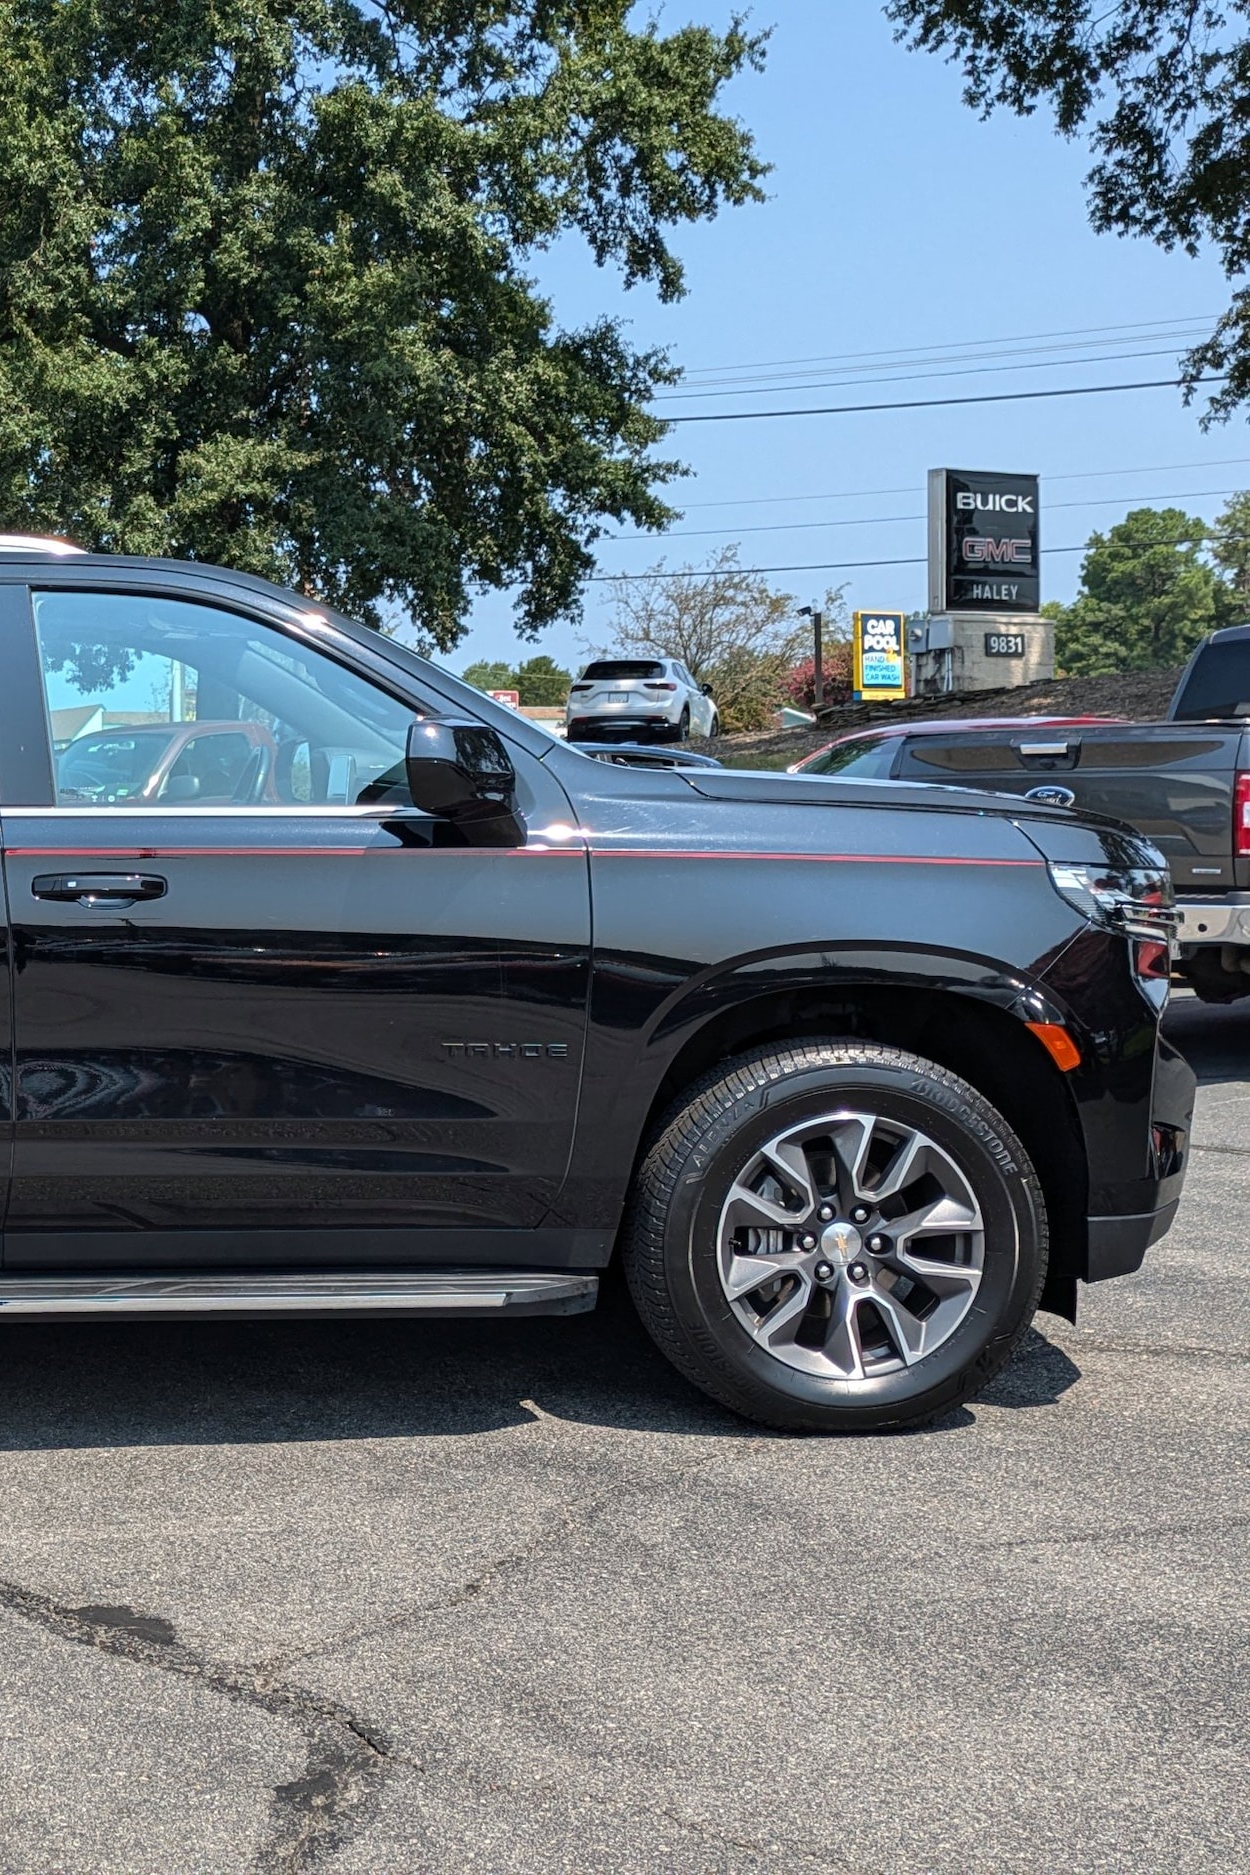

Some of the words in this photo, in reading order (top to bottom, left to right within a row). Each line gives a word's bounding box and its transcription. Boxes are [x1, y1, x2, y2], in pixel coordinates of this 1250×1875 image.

[956, 492, 1035, 513] BUICK
[962, 537, 1032, 562] GMC
[973, 584, 1018, 600] HALEY
[867, 619, 896, 635] CAR
[864, 634, 900, 651] POOL
[990, 636, 1022, 653] 9831
[865, 655, 885, 663] HAND
[865, 664, 896, 673] FINISHED
[865, 673, 880, 681] CAR
[881, 673, 900, 681] WASH
[442, 1043, 568, 1057] TAHOE
[911, 1079, 1019, 1176] BRIDGESTONE
